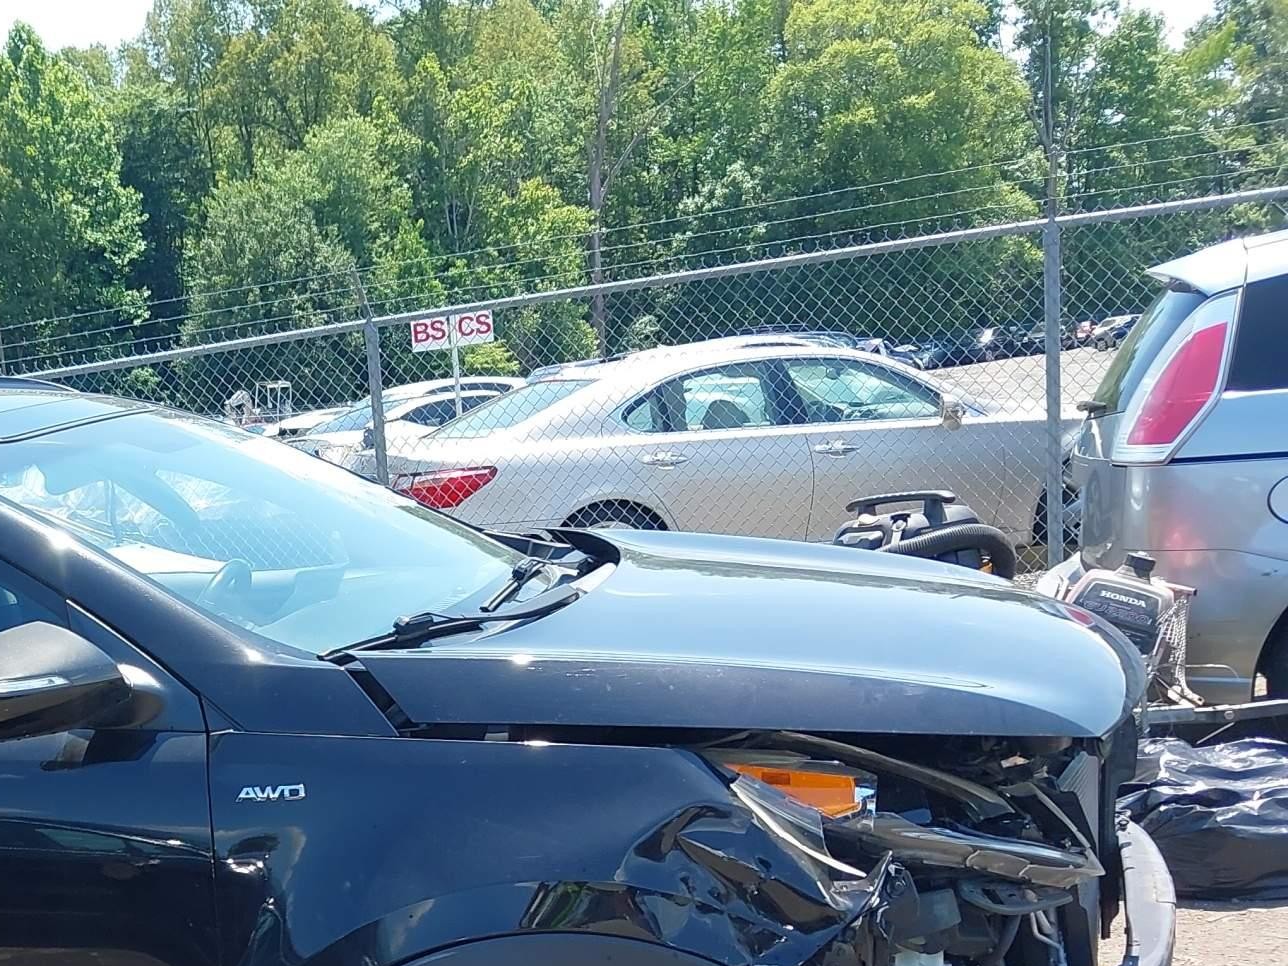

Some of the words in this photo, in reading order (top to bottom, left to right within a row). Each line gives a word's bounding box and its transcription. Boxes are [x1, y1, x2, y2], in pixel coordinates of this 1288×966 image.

[413, 320, 447, 343] BS
[458, 314, 491, 337] CS
[1099, 590, 1147, 608] HONDA
[235, 784, 306, 802] AWD
